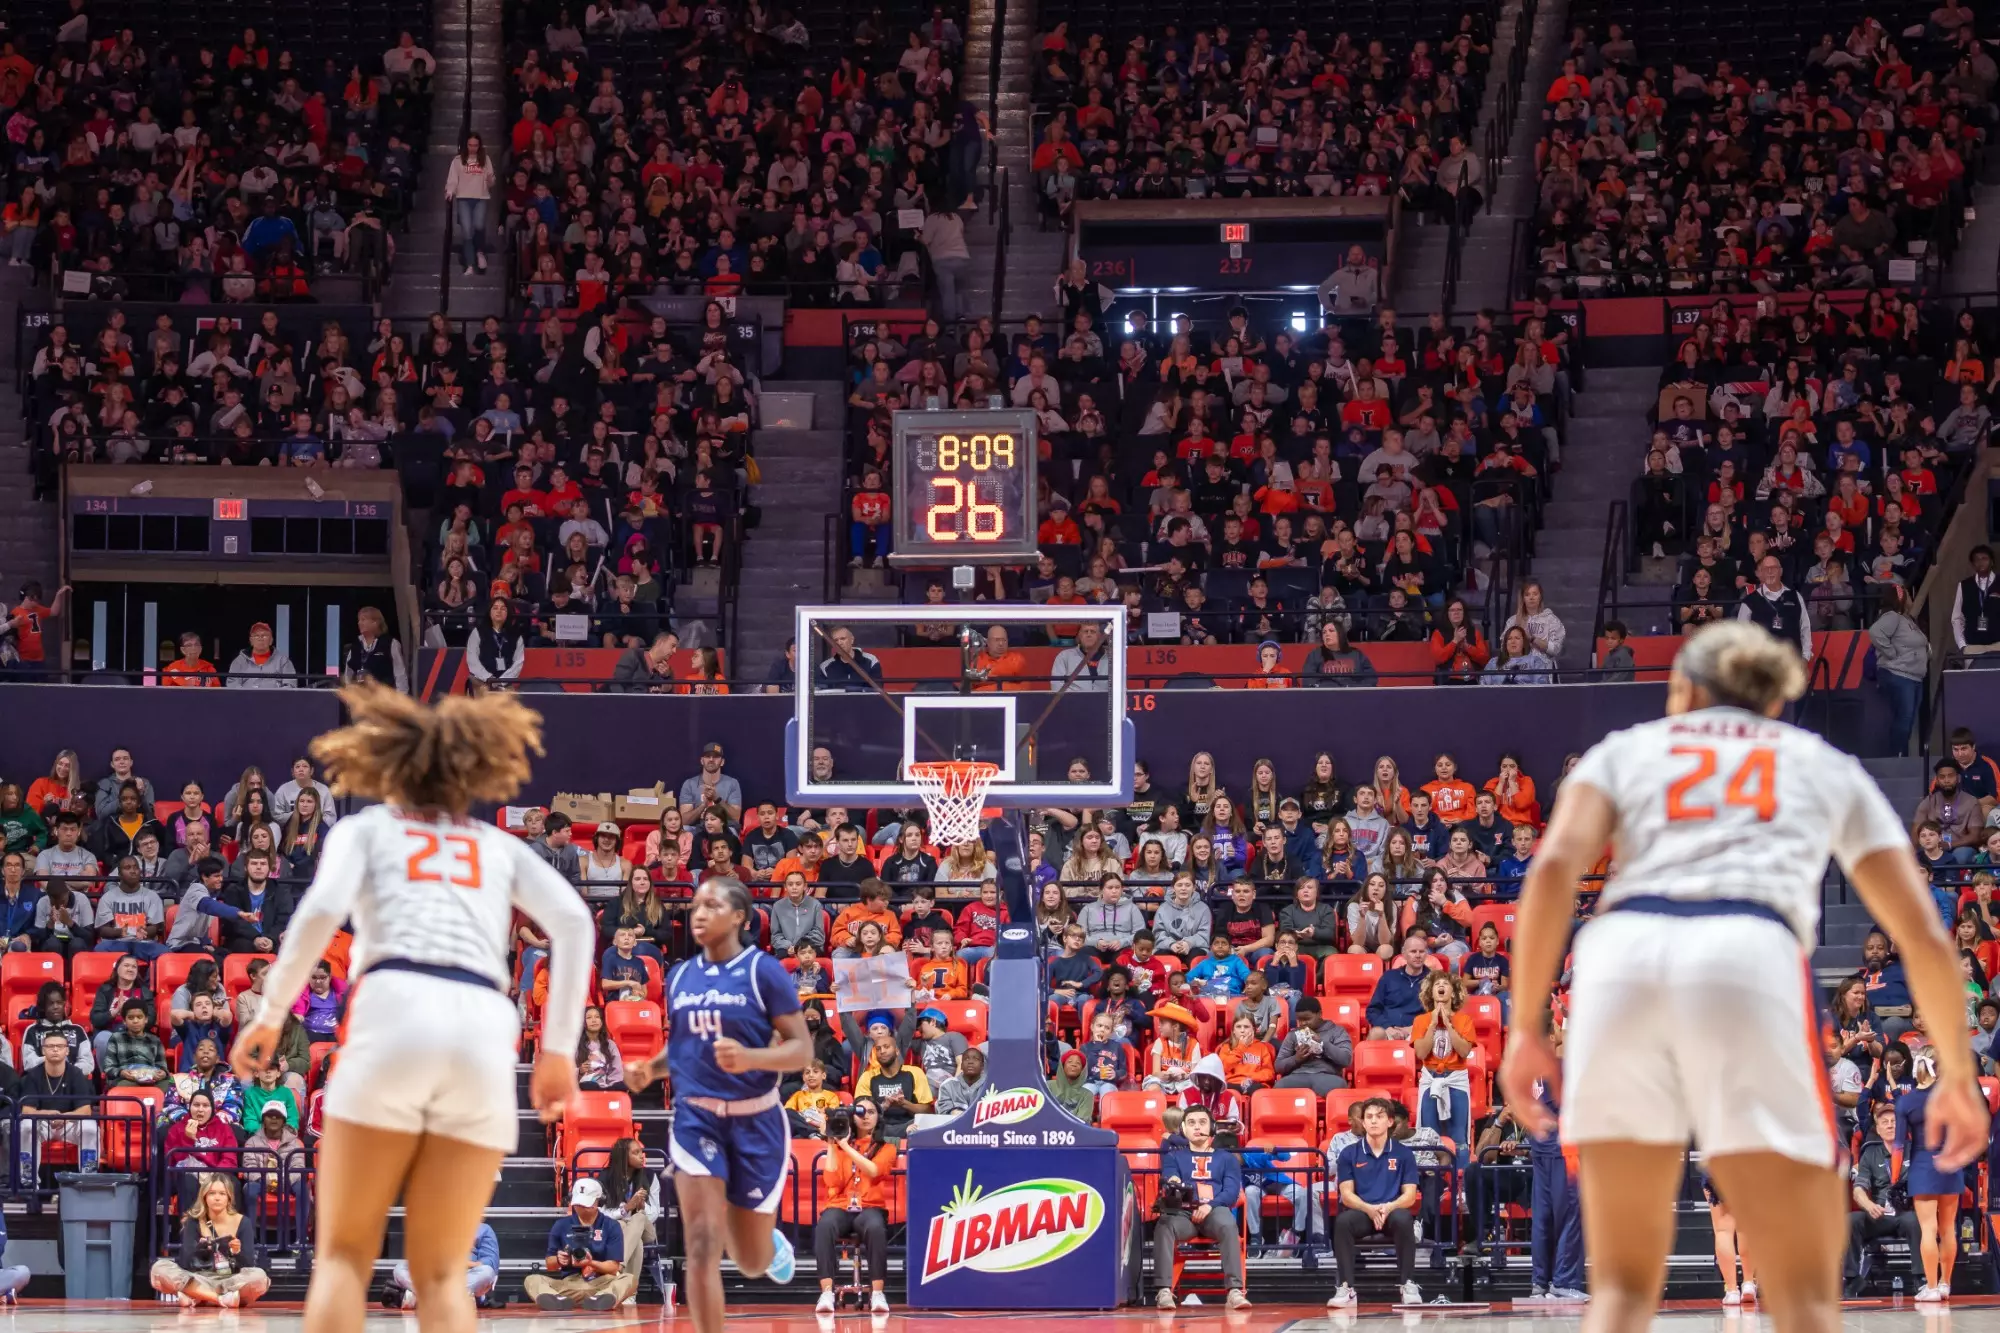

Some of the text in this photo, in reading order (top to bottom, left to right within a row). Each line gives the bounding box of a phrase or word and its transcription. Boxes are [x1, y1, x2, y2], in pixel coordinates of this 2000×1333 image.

[1225, 224, 1245, 240] EXIT
[1092, 260, 1126, 275] 236
[1219, 259, 1252, 274] 237
[1676, 311, 1700, 324] 137
[939, 434, 1014, 471] 8:09
[85, 500, 108, 511] 134
[220, 499, 242, 518] EXIT
[354, 504, 377, 516] 136
[927, 477, 1004, 541] 26
[555, 652, 586, 668] 135
[1145, 650, 1177, 665] 136
[1127, 694, 1157, 711] 16
[1665, 746, 1780, 822] 24
[405, 829, 482, 889] 23
[688, 1009, 724, 1041] 44
[975, 1093, 1038, 1126] LIBMAN
[943, 1129, 1076, 1147] Cleaning Since 1896
[925, 1193, 1089, 1277] LIBMAN
